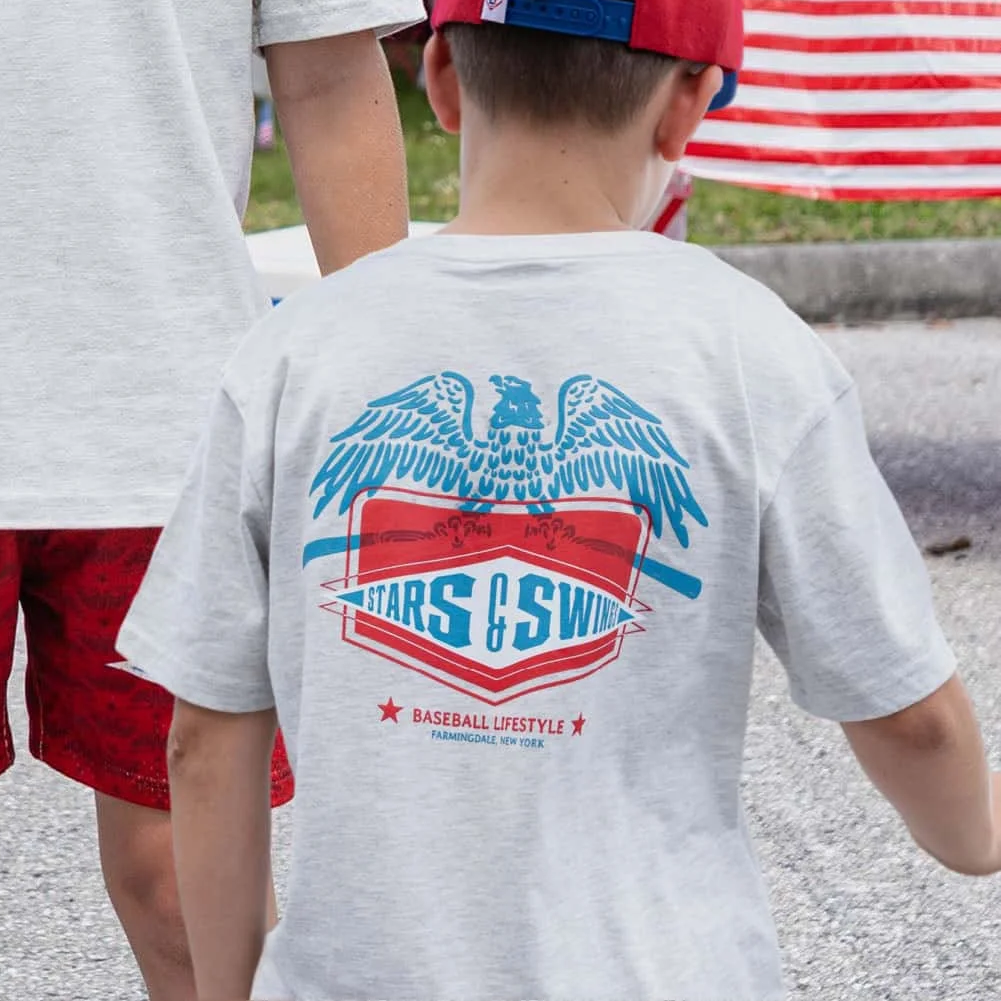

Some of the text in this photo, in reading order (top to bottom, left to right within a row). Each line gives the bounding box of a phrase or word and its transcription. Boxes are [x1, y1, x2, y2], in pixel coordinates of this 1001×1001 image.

[367, 573, 476, 648] STARS
[486, 572, 508, 653] &
[413, 708, 564, 735] BASEBALL LIFESTYLE
[431, 729, 545, 749] FARMINGDALE, NEW YORK
